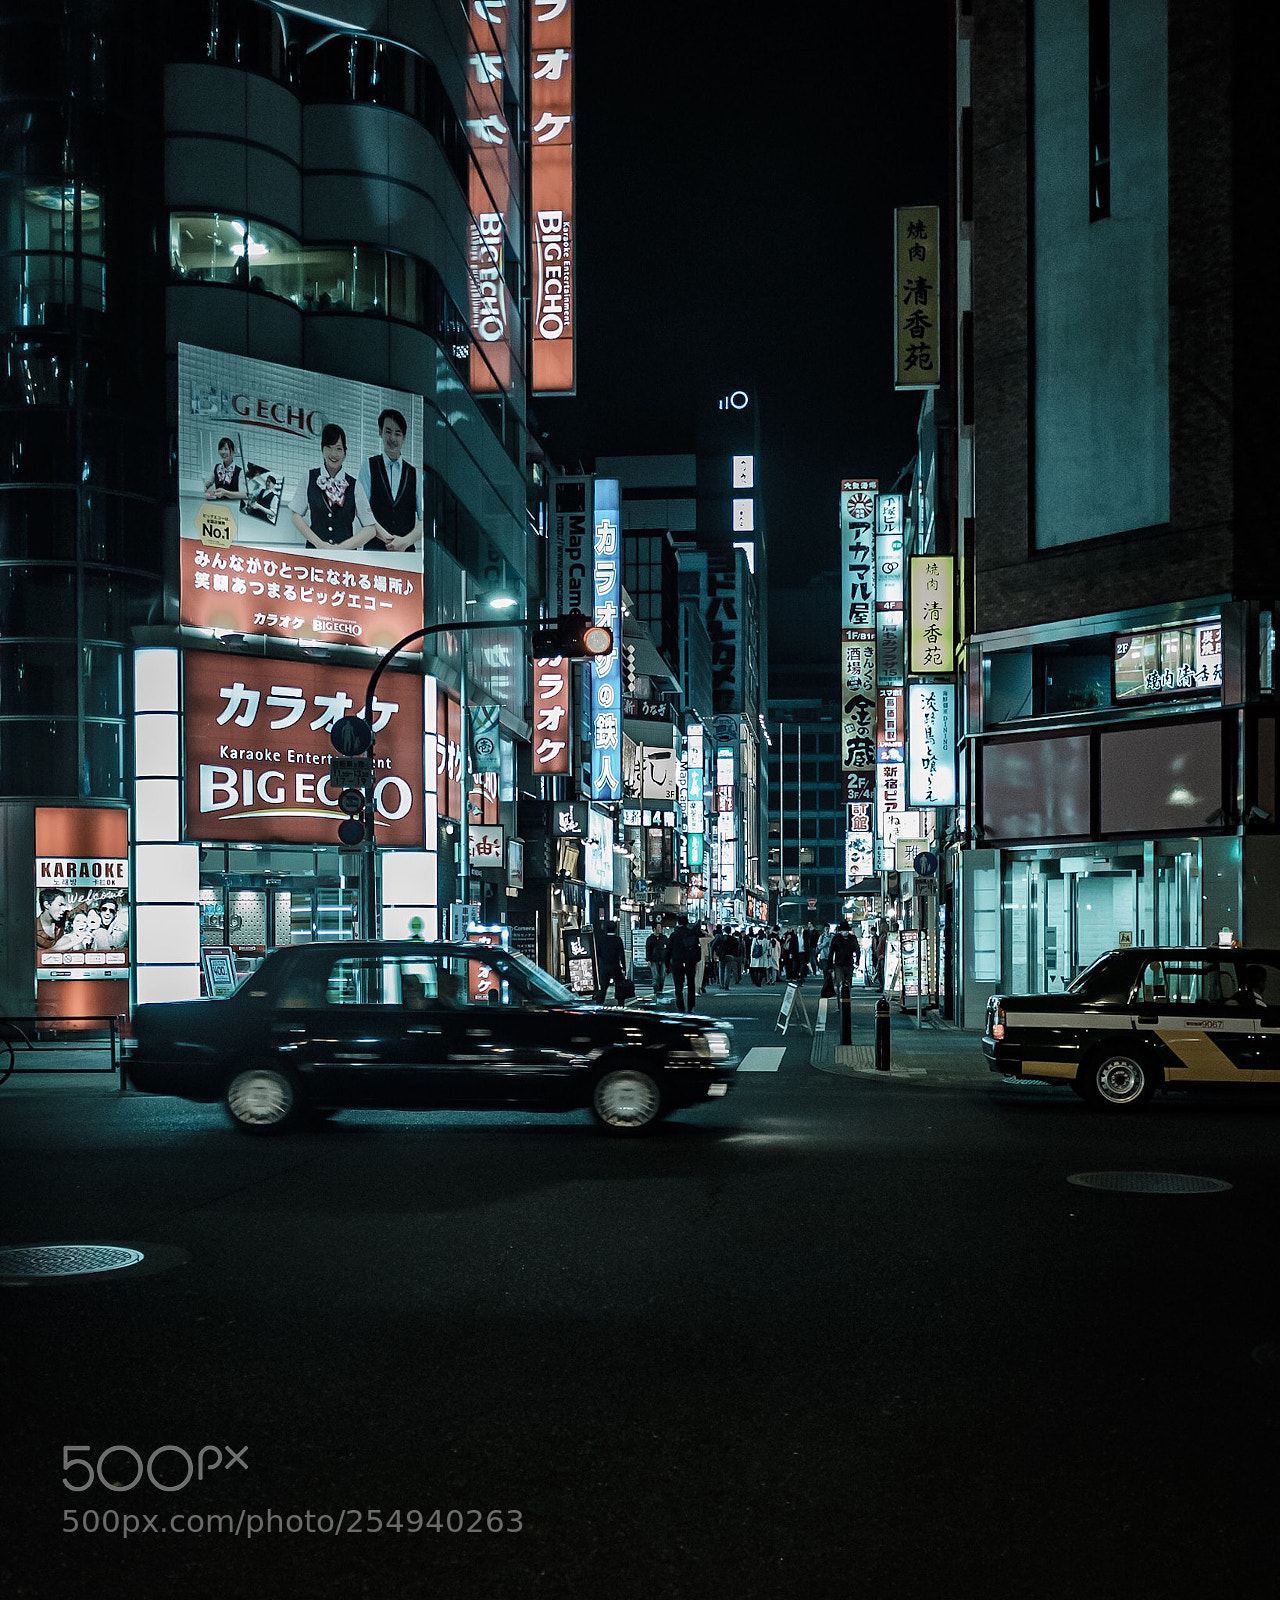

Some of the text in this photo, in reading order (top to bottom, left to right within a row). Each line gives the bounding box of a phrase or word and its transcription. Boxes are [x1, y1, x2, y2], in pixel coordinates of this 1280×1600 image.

[562, 222, 570, 258] Karaoke
[537, 211, 564, 340] BIG ECHO
[903, 220, 934, 371] 焼肉 清香苑
[202, 523, 230, 540] No.1
[564, 516, 585, 561] Map
[193, 571, 394, 611] 笑顔あつまるビッグエコー
[848, 522, 872, 625] アカマル屋
[253, 612, 305, 631] カラオケ
[884, 602, 896, 610] 4F
[923, 562, 943, 666] 焼肉 清香苑
[312, 619, 333, 632] BIG
[334, 622, 363, 637] ECHO
[1116, 643, 1129, 655] 2F
[863, 646, 875, 691] きんくら
[216, 682, 400, 733] カラオケ
[642, 700, 667, 717] うなぎ
[220, 745, 282, 762] Karaoke
[287, 749, 392, 769] Entertnt
[200, 764, 413, 821] BIG ECO
[41, 862, 124, 878] KARAOKE
[67, 888, 125, 903] Welcome
